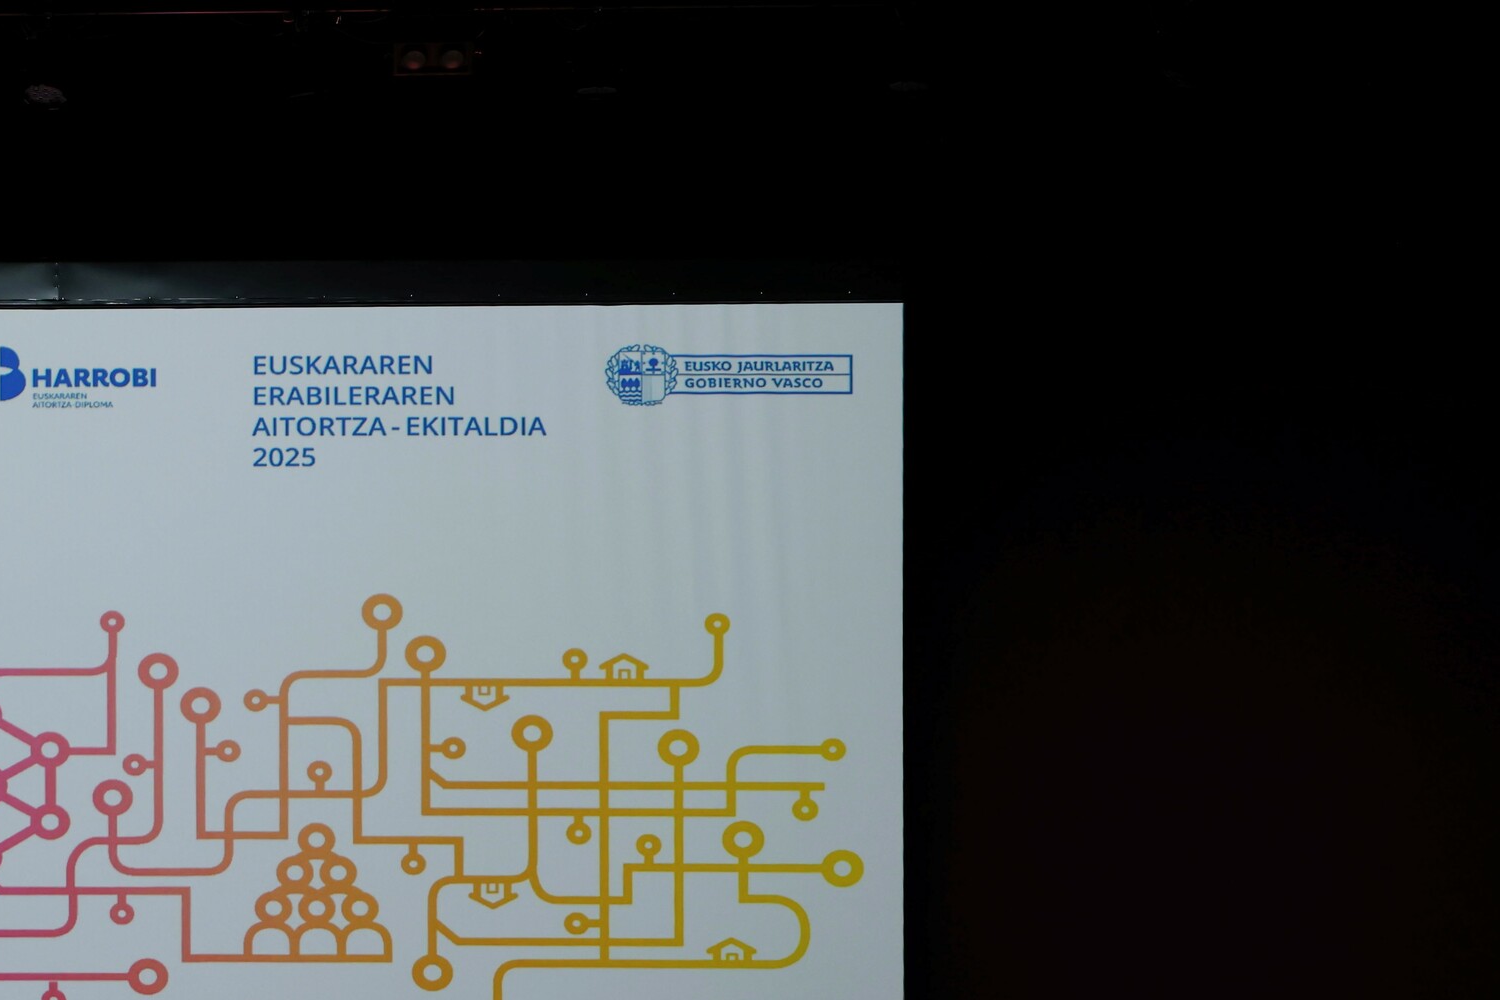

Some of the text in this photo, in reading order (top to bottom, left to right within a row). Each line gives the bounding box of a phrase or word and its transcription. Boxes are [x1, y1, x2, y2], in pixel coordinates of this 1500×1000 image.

[253, 355, 433, 375] EUSKARAREN
[684, 360, 834, 373] EUSKO JAURLARITZA
[32, 368, 156, 388] HARROBI
[684, 378, 823, 389] GOBIERNO VASCO
[253, 386, 454, 406] ERABILERAREN
[253, 448, 316, 467] 2025
